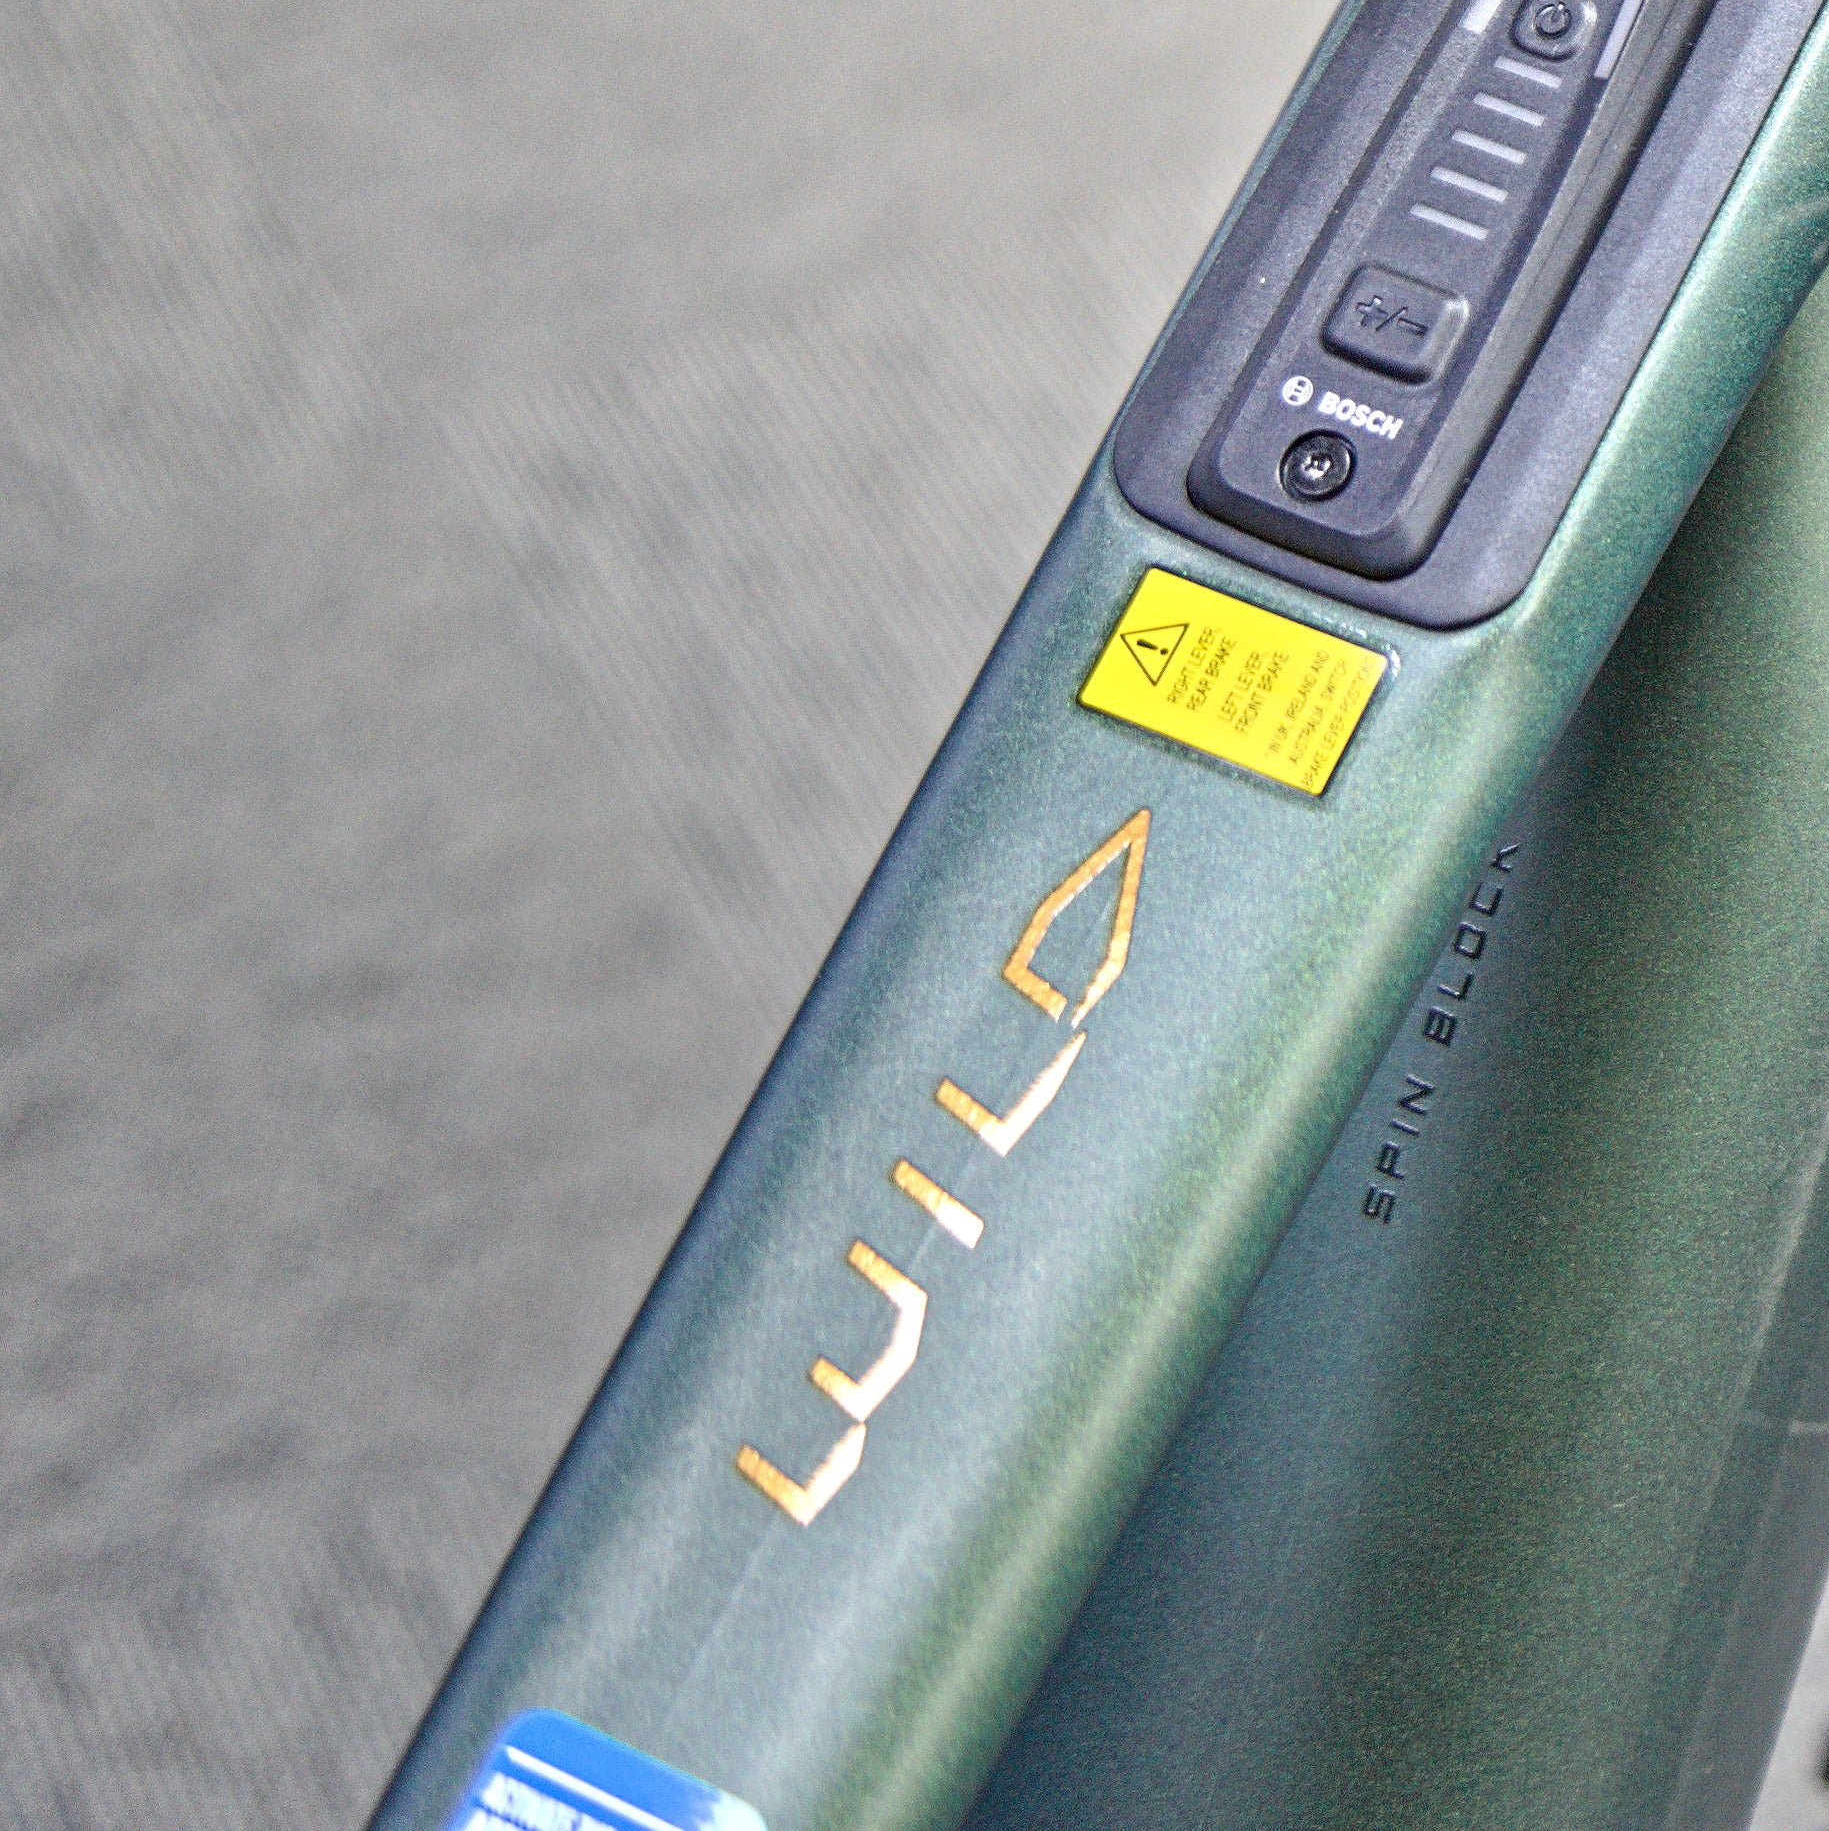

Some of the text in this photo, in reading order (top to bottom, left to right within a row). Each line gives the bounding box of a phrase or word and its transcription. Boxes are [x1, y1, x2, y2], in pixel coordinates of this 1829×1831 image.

[1318, 391, 1404, 440] BOSCH
[1165, 664, 1194, 705] RIGHT
[1185, 634, 1237, 712] REAR BRAKE
[1216, 689, 1242, 723] LEFT
[1233, 649, 1290, 735] FRONT BRAKE
[1362, 842, 1521, 1224] SPIN BLOCK
[737, 807, 1151, 1527] WILD
